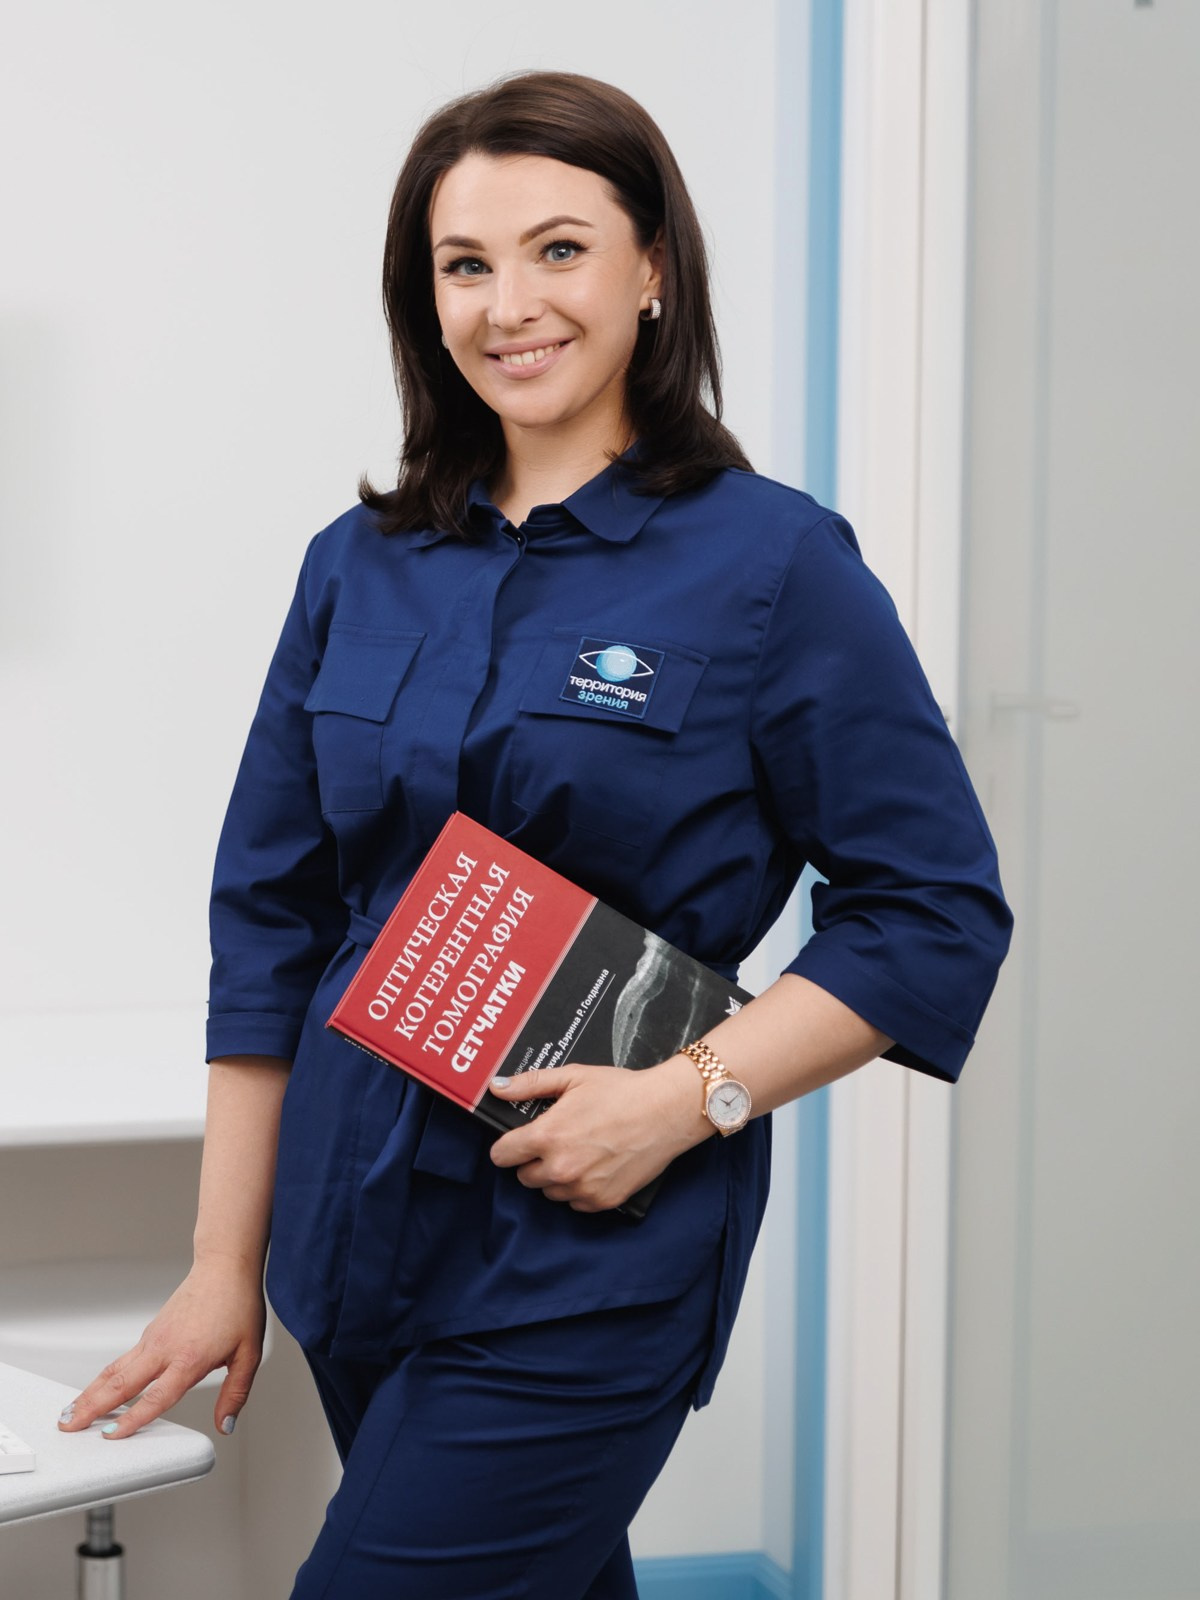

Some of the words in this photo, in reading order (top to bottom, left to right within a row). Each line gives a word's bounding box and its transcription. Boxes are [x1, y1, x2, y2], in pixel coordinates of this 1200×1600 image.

[570, 675, 647, 702] территория
[577, 690, 629, 710] зрения
[368, 851, 479, 1021] ОПТИЧЕСКАЯ
[394, 862, 511, 1041] КОГЕРЕНТНАЯ
[422, 886, 535, 1055] ТОМОГРАФИЯ
[451, 960, 527, 1073] СЕТЧАТКИ
[558, 1016, 582, 1051] Дэрина
[576, 1008, 586, 1017] Р.
[581, 968, 610, 1010] Голдмана
